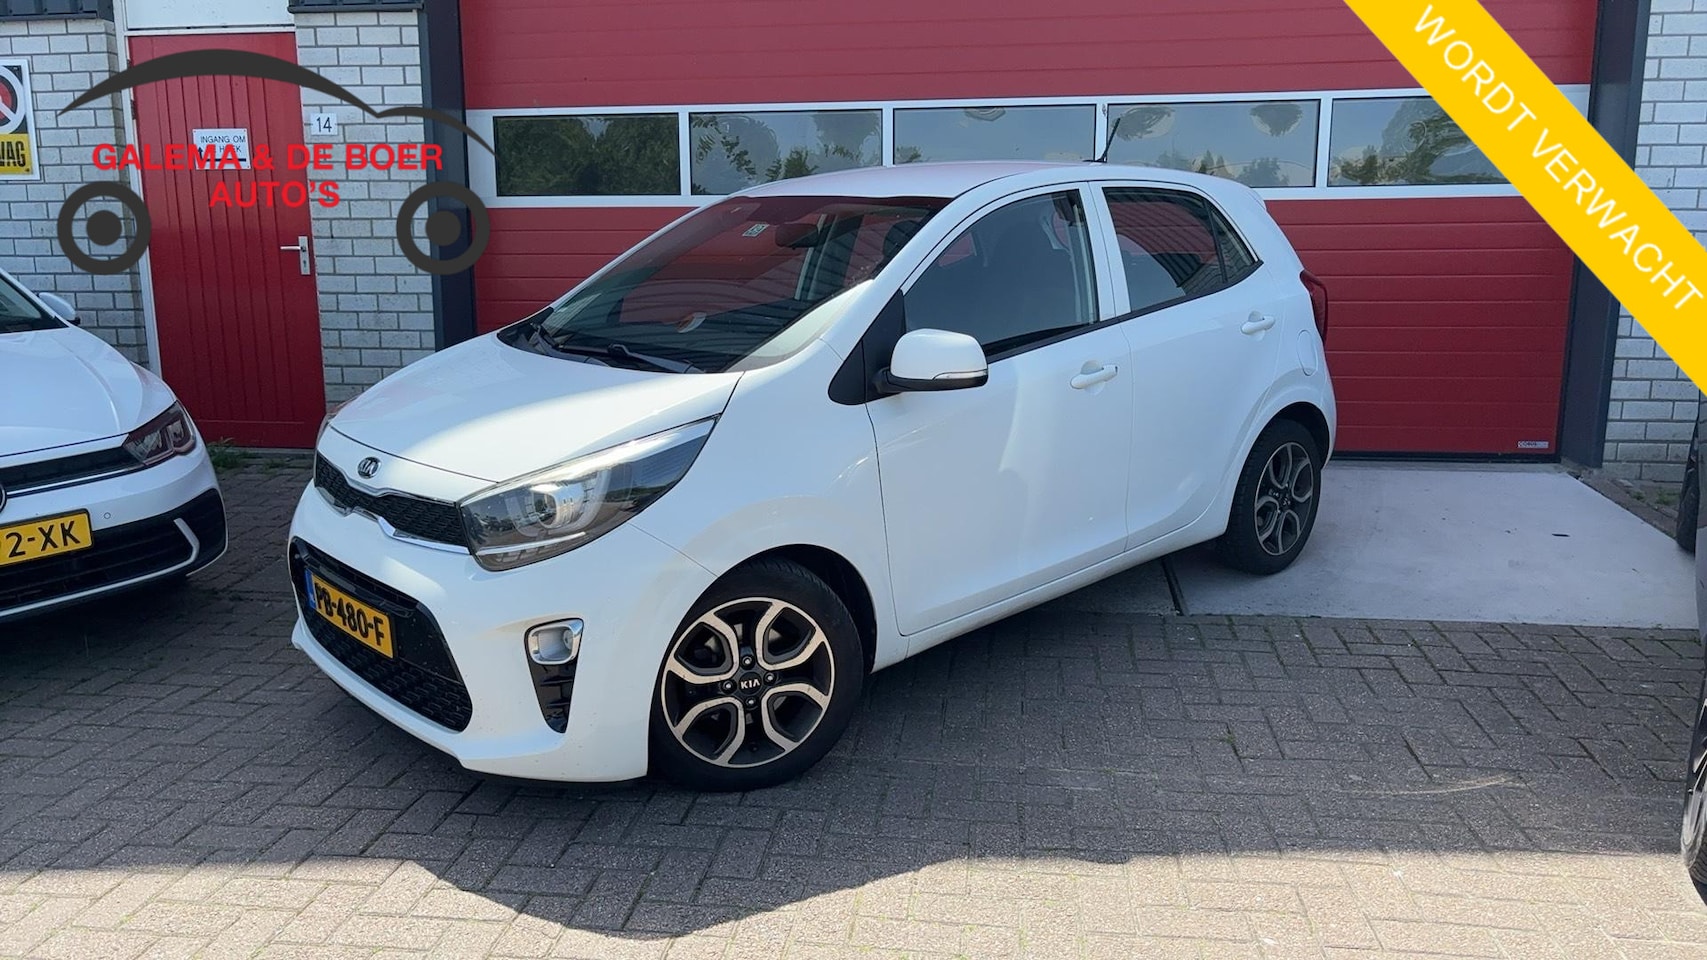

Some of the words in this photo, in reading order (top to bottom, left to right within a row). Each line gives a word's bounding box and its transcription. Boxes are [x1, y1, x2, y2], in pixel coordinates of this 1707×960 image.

[316, 116, 333, 133] 14
[200, 135, 231, 143] INGANG
[232, 135, 246, 143] OM
[314, 582, 385, 647] PB-480-F
[740, 678, 761, 689] KIA
